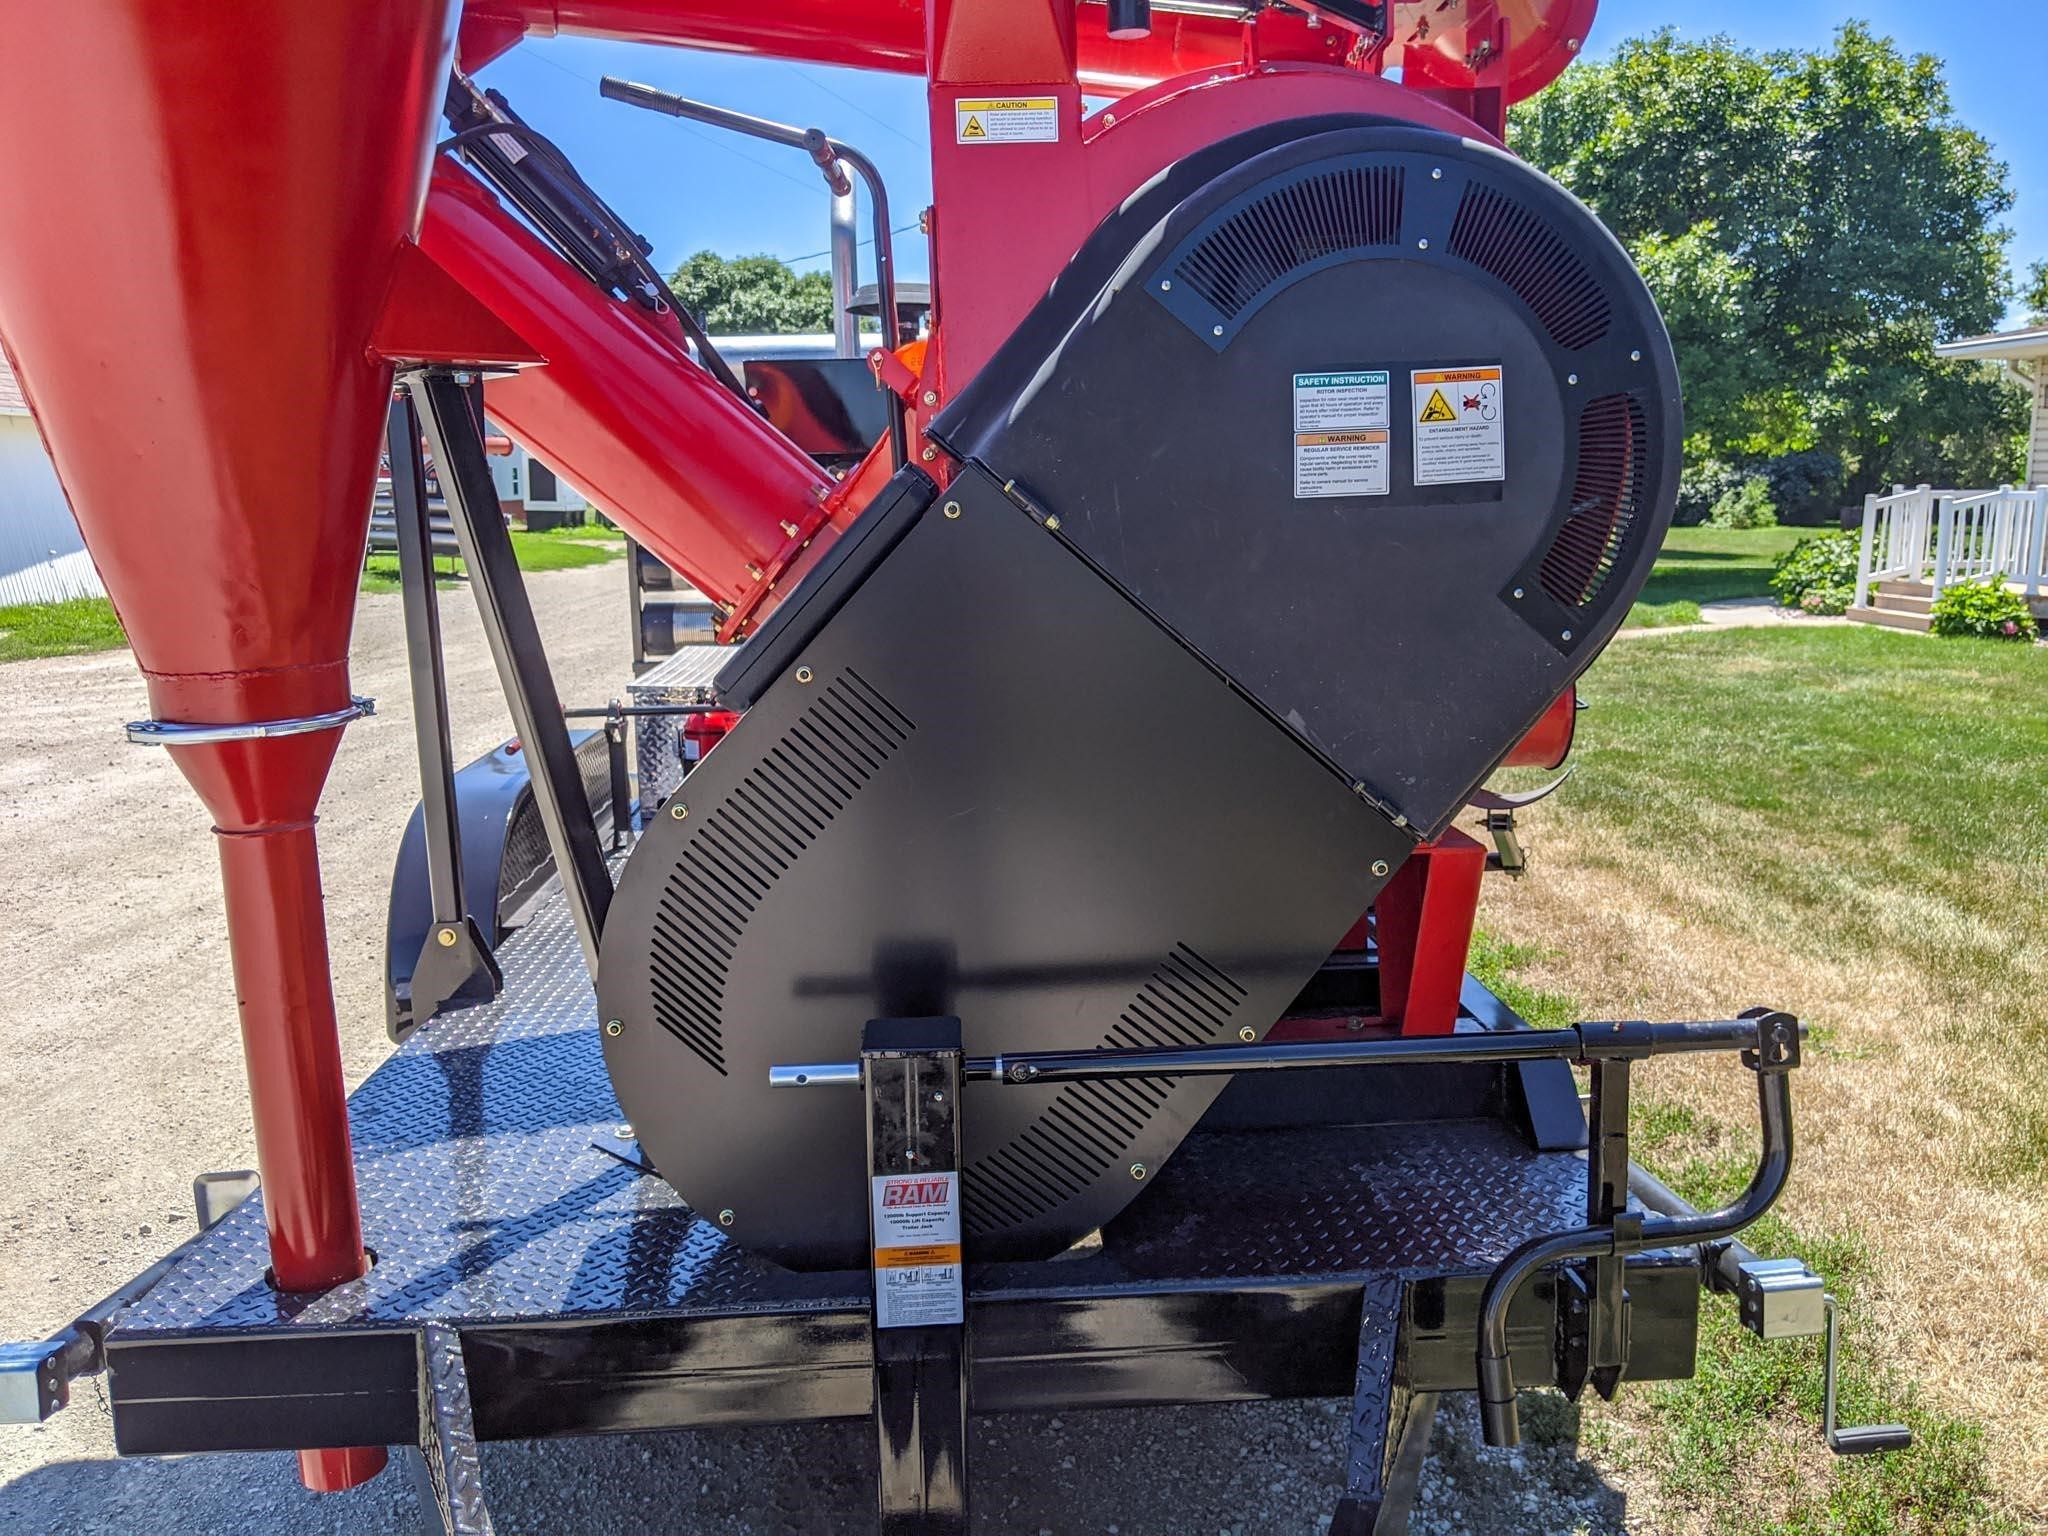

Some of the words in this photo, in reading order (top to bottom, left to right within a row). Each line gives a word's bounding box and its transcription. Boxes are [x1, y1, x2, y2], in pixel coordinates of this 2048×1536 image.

[1298, 377, 1330, 386] SAFETY
[1332, 375, 1384, 385] INSTRUCTION
[1444, 372, 1481, 380] WARNING
[1328, 434, 1366, 442] WARNING
[884, 1183, 946, 1205] RAM
